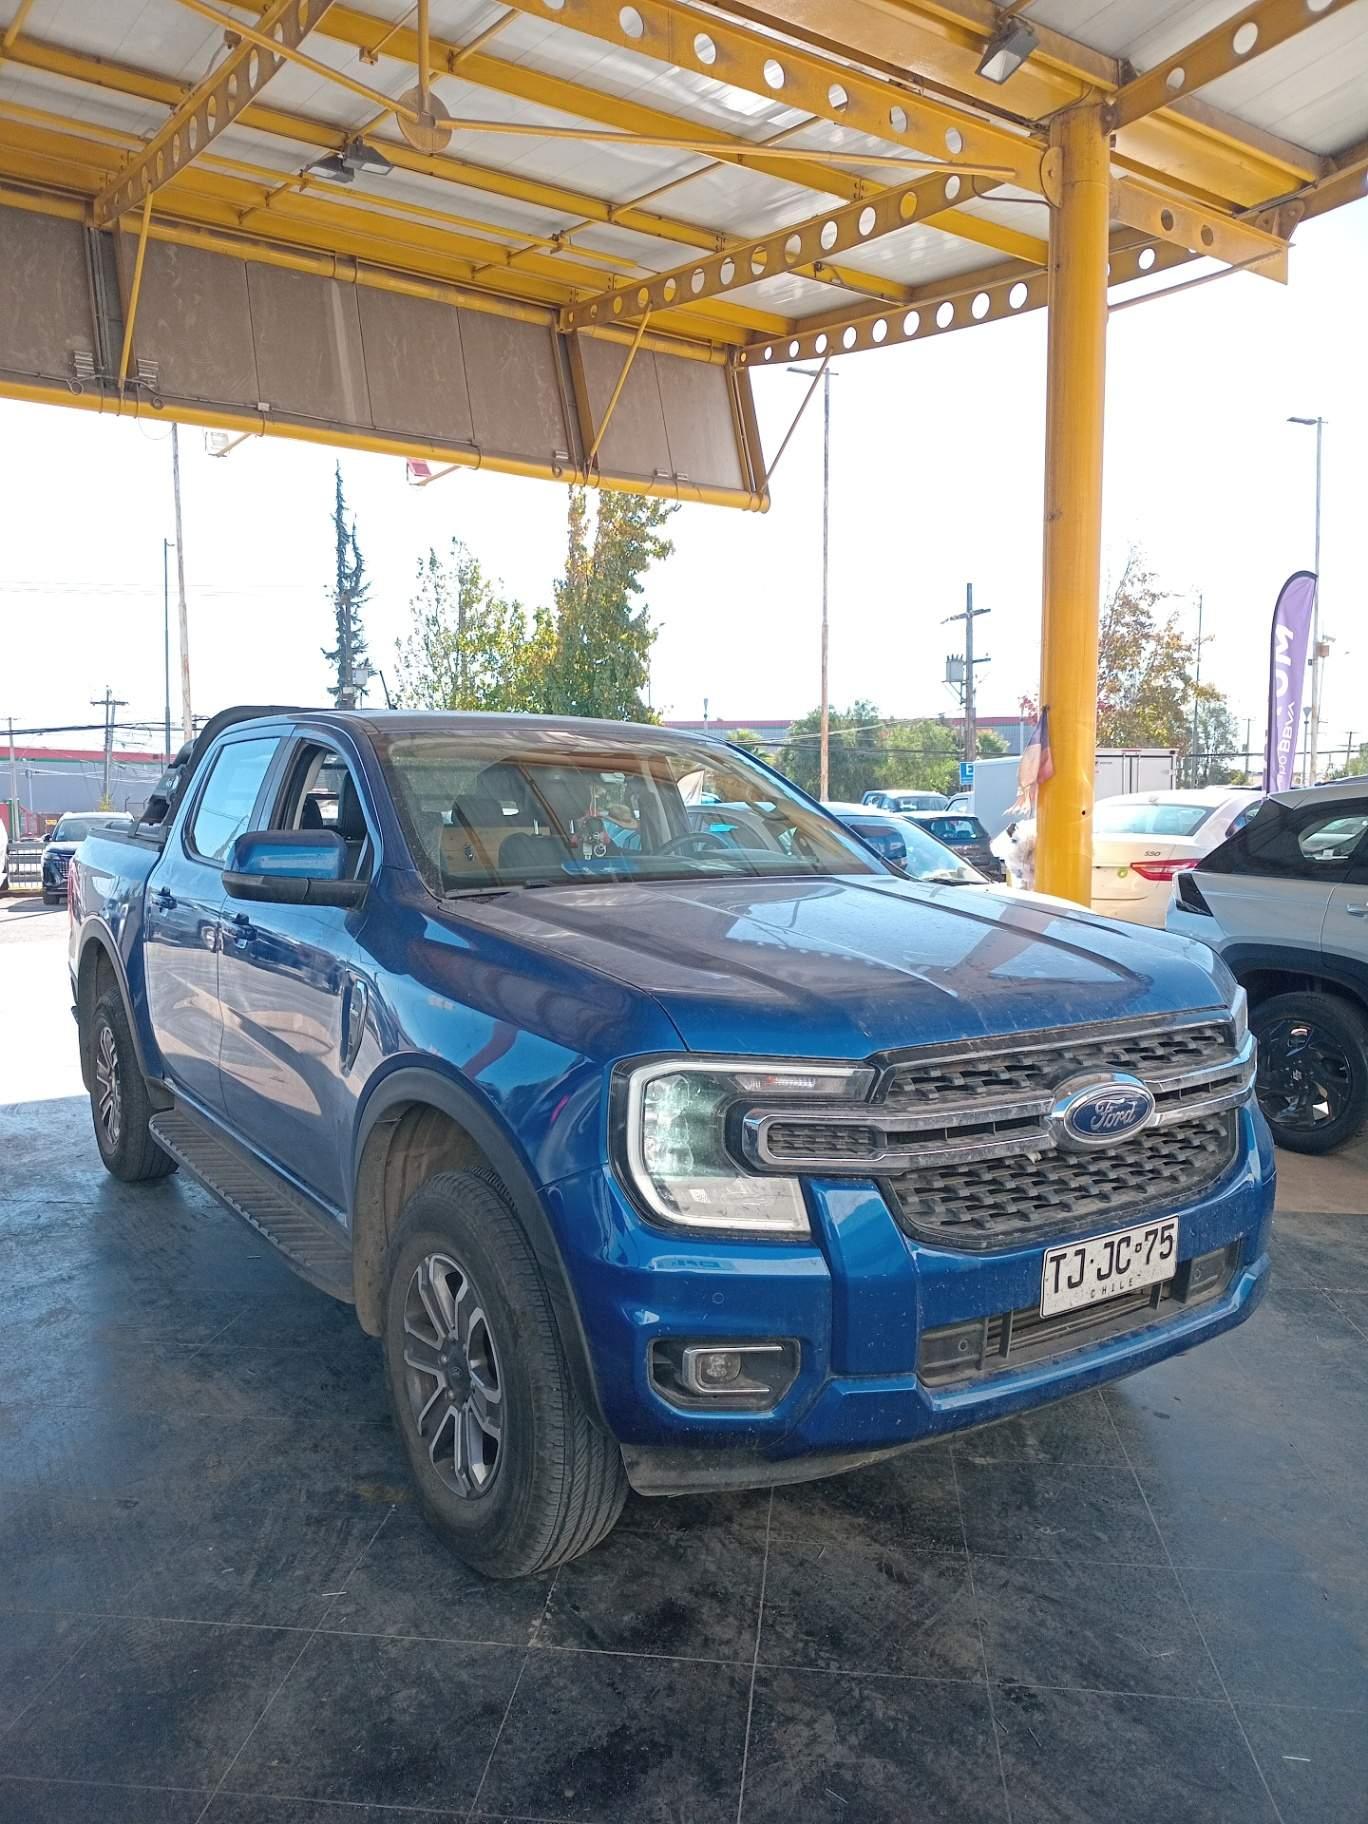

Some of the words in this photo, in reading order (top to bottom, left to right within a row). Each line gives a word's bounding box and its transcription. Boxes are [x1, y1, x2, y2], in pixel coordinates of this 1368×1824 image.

[1279, 701, 1295, 753] BBVA
[1090, 1098, 1138, 1130] Ford
[1090, 1278, 1133, 1299] CHILE
